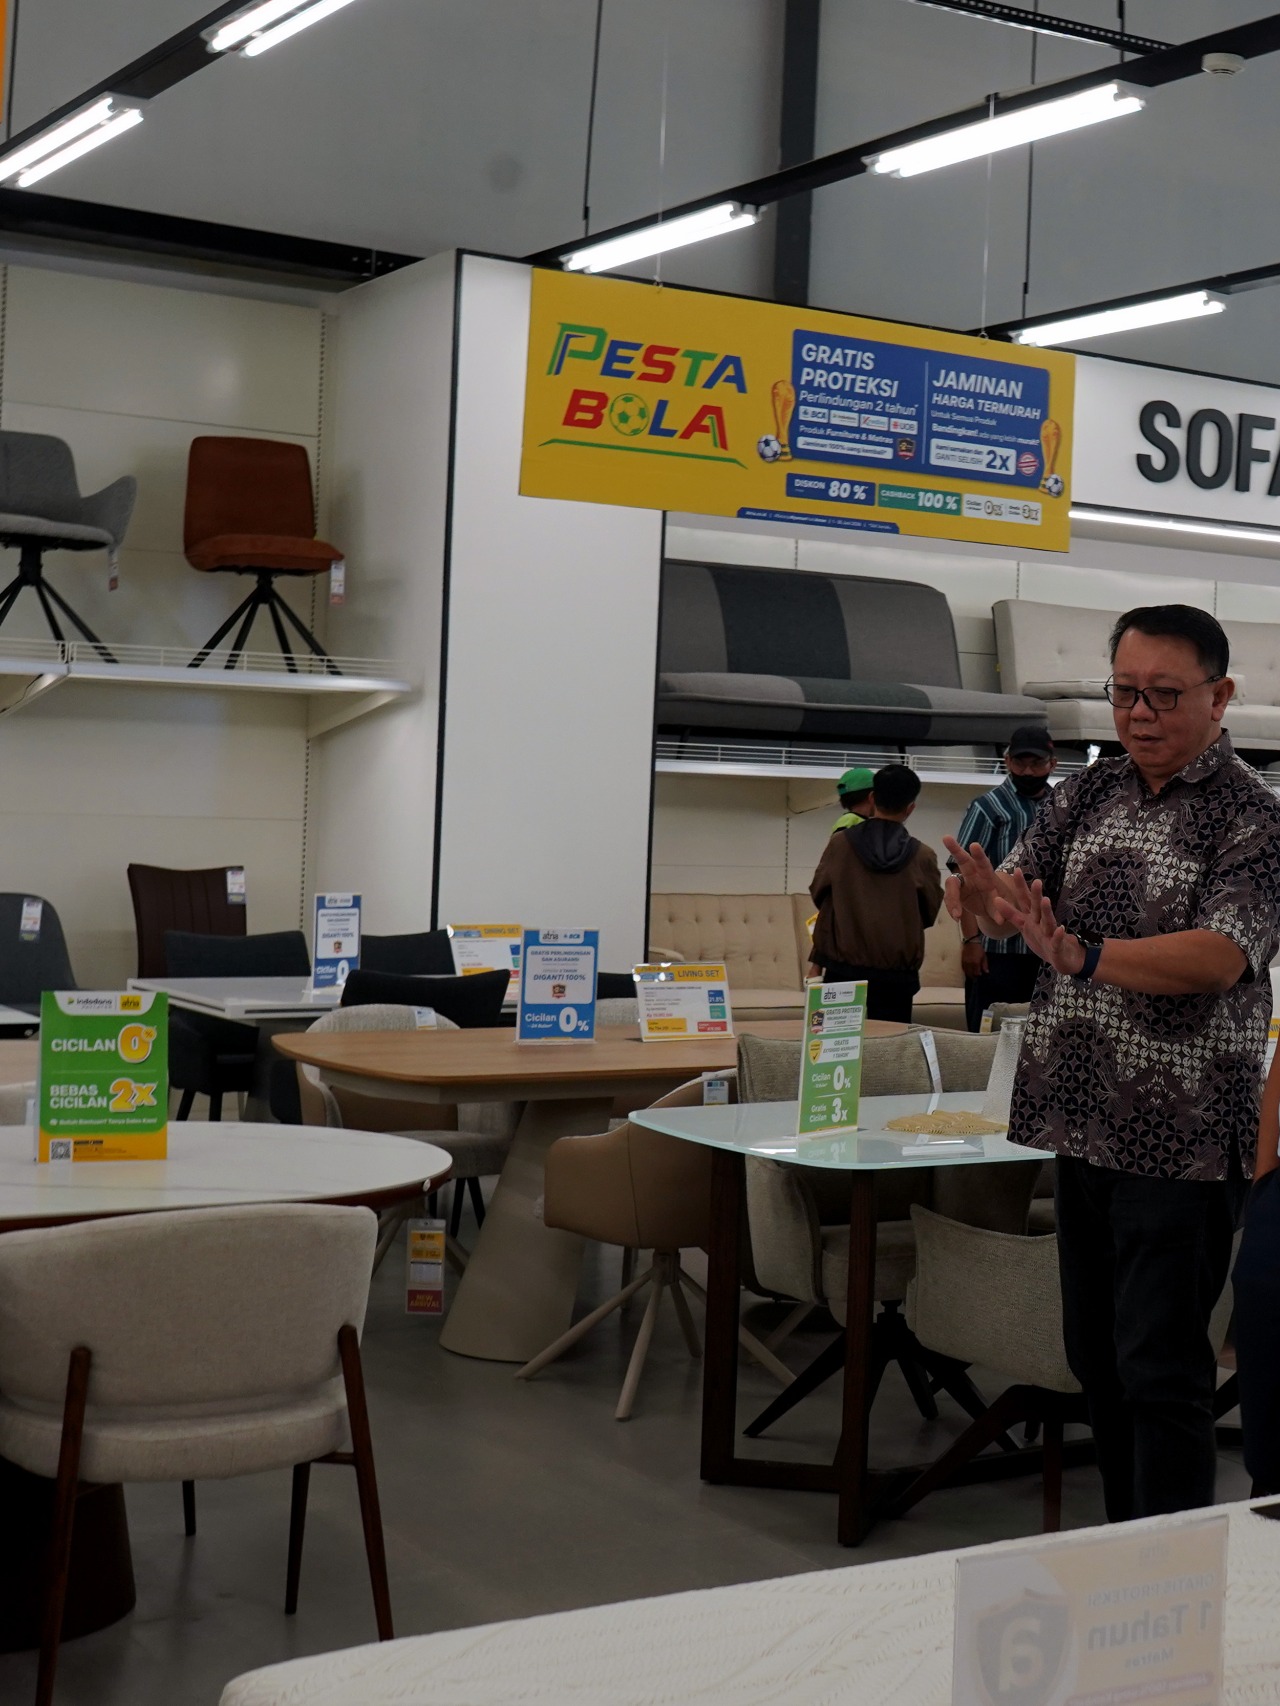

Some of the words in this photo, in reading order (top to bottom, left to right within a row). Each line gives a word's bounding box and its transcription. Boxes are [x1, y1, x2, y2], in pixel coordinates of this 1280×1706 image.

[547, 322, 747, 394] PESTA
[801, 343, 875, 371] GRATIS
[800, 367, 899, 398] PROTEKSI
[932, 369, 1023, 400] JAMINAN
[799, 390, 874, 411] Perlindungan
[874, 400, 884, 412] 2
[932, 393, 975, 410] HARGA
[977, 399, 1041, 420] TERMURAH
[930, 410, 951, 419] Untuk
[951, 412, 973, 423] Semua
[975, 416, 997, 426] Produk
[800, 425, 824, 435] Produk
[825, 428, 860, 440] Furniture
[900, 422, 915, 432] UOB
[794, 479, 825, 490] DISKON
[880, 489, 916, 500] CASHBACK
[542, 931, 559, 940] atria
[677, 969, 704, 978] LIVING
[705, 969, 720, 978] SET
[121, 997, 140, 1010] atria
[525, 1012, 557, 1022] Cicilan
[51, 1038, 116, 1052] CICILAN
[811, 1073, 831, 1082] Cicilan
[49, 1084, 98, 1097] BEBAS
[49, 1096, 107, 1109] CICILAN
[811, 1104, 827, 1113] Gratis
[809, 1114, 827, 1123] Cicilan
